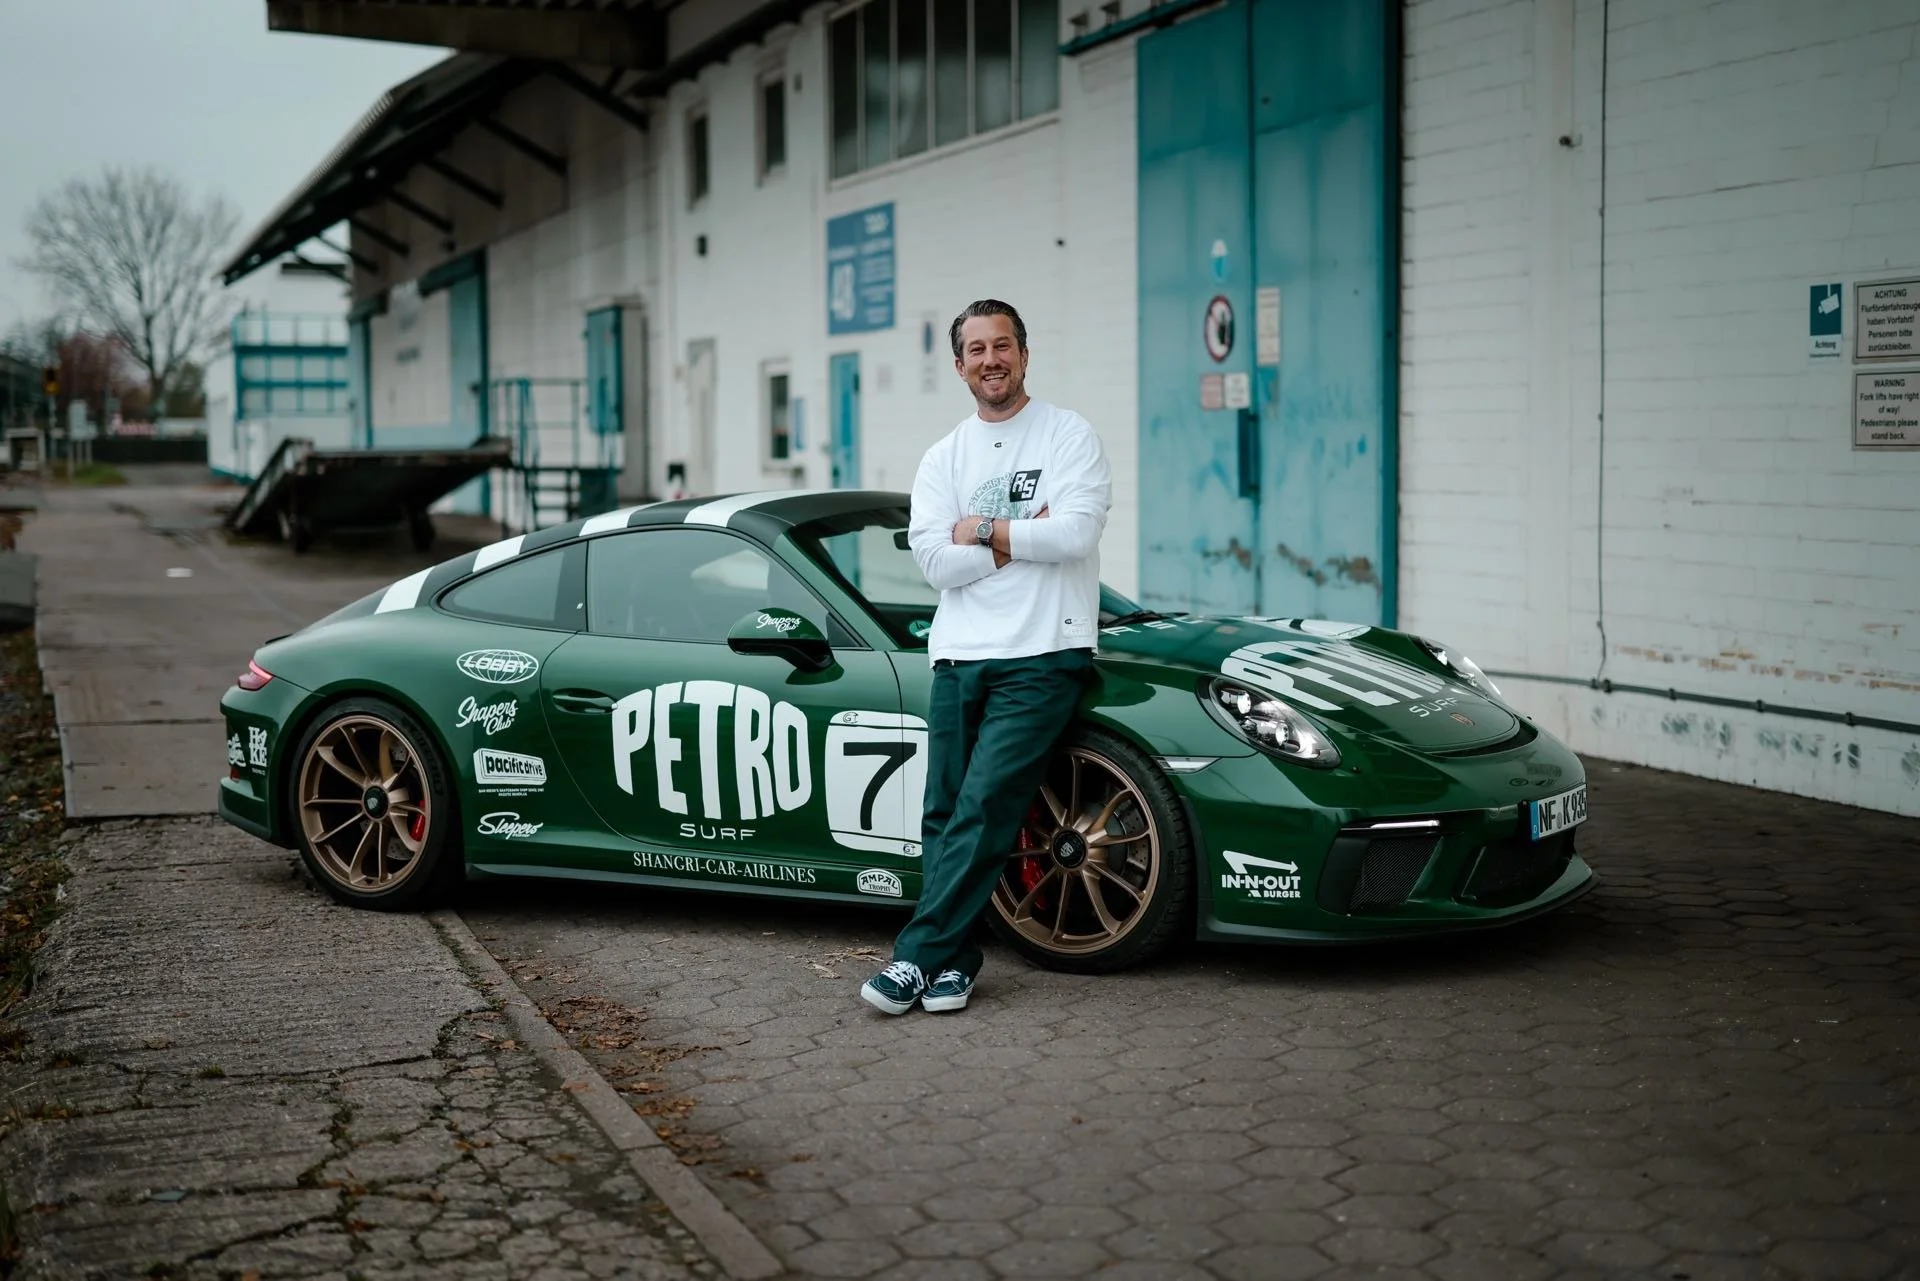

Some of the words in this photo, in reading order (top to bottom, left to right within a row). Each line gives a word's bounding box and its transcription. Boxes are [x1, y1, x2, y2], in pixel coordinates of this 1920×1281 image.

[1874, 288, 1907, 299] ACHTUNG
[1867, 318, 1886, 326] haben
[1887, 315, 1914, 325] Vorfahrt!
[1868, 330, 1898, 339] Personen
[1899, 329, 1913, 337] bitte
[1874, 378, 1906, 388] WARNING
[1860, 392, 1874, 400] Fork
[1876, 392, 1887, 400] lifts
[1889, 392, 1903, 400] have
[1905, 391, 1919, 402] right
[1878, 405, 1885, 413] of
[1860, 418, 1897, 427] Pedestrians
[1898, 418, 1919, 428] please
[1871, 432, 1888, 440] stand
[1012, 472, 1036, 500] RS
[756, 613, 802, 630] Shapers
[463, 655, 533, 674] LOBBY
[456, 696, 518, 727] Shapers
[1408, 697, 1458, 718] SURF
[611, 679, 812, 820] PETRO
[485, 755, 524, 774] pacific
[525, 760, 543, 776] drive
[843, 741, 918, 831] 7
[1539, 800, 1557, 834] NF
[1563, 795, 1571, 826] K
[477, 811, 544, 840] Sleepers
[679, 823, 757, 841] SURF
[633, 852, 816, 884] SHANGRI-CAR-AIRLINES
[861, 873, 898, 890] AMPAL
[869, 884, 891, 892] TROPHY
[1222, 874, 1301, 890] IN-N-OUT
[1263, 890, 1301, 898] BURGER
